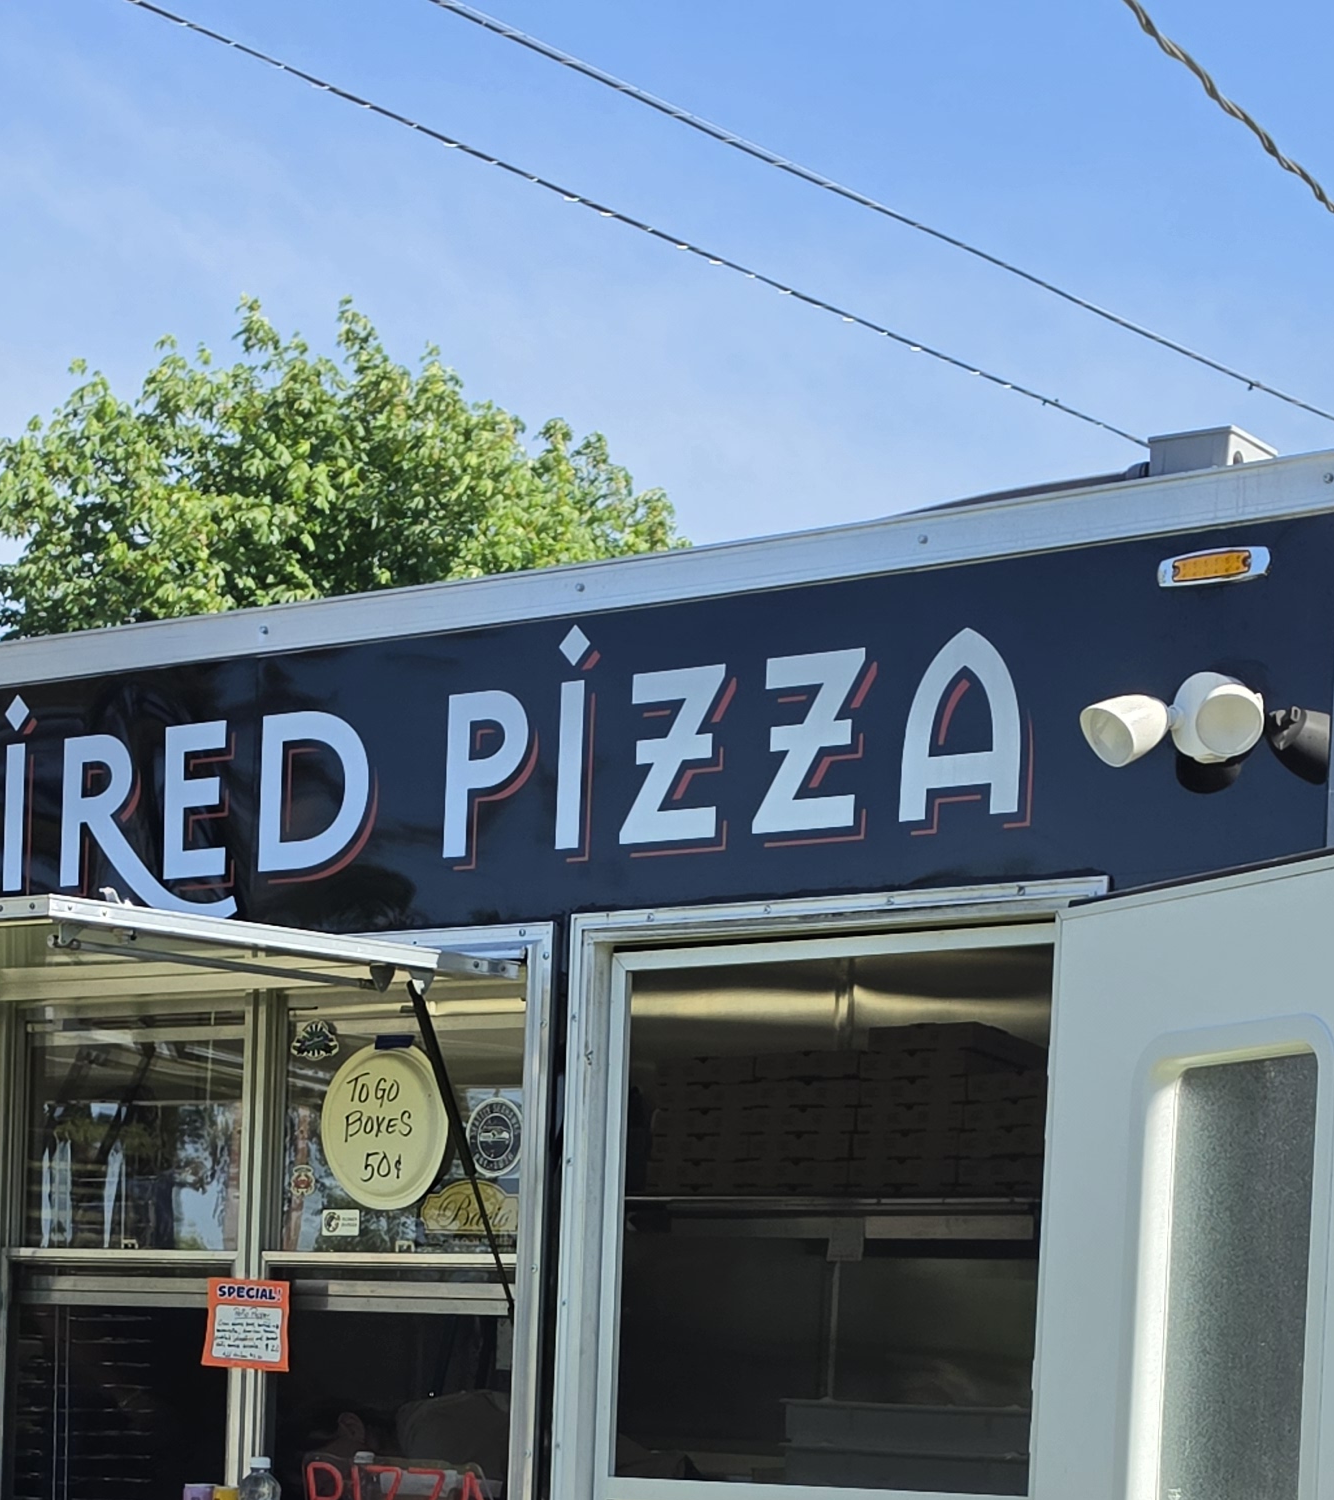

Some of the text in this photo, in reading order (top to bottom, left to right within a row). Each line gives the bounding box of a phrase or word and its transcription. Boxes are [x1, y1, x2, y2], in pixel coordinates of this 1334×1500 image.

[441, 623, 1031, 868] PIZZA
[346, 1072, 400, 1108] TO GO
[344, 1110, 413, 1142] BOXES
[436, 1191, 512, 1228] Baio
[217, 1284, 283, 1302] SPECIAL!
